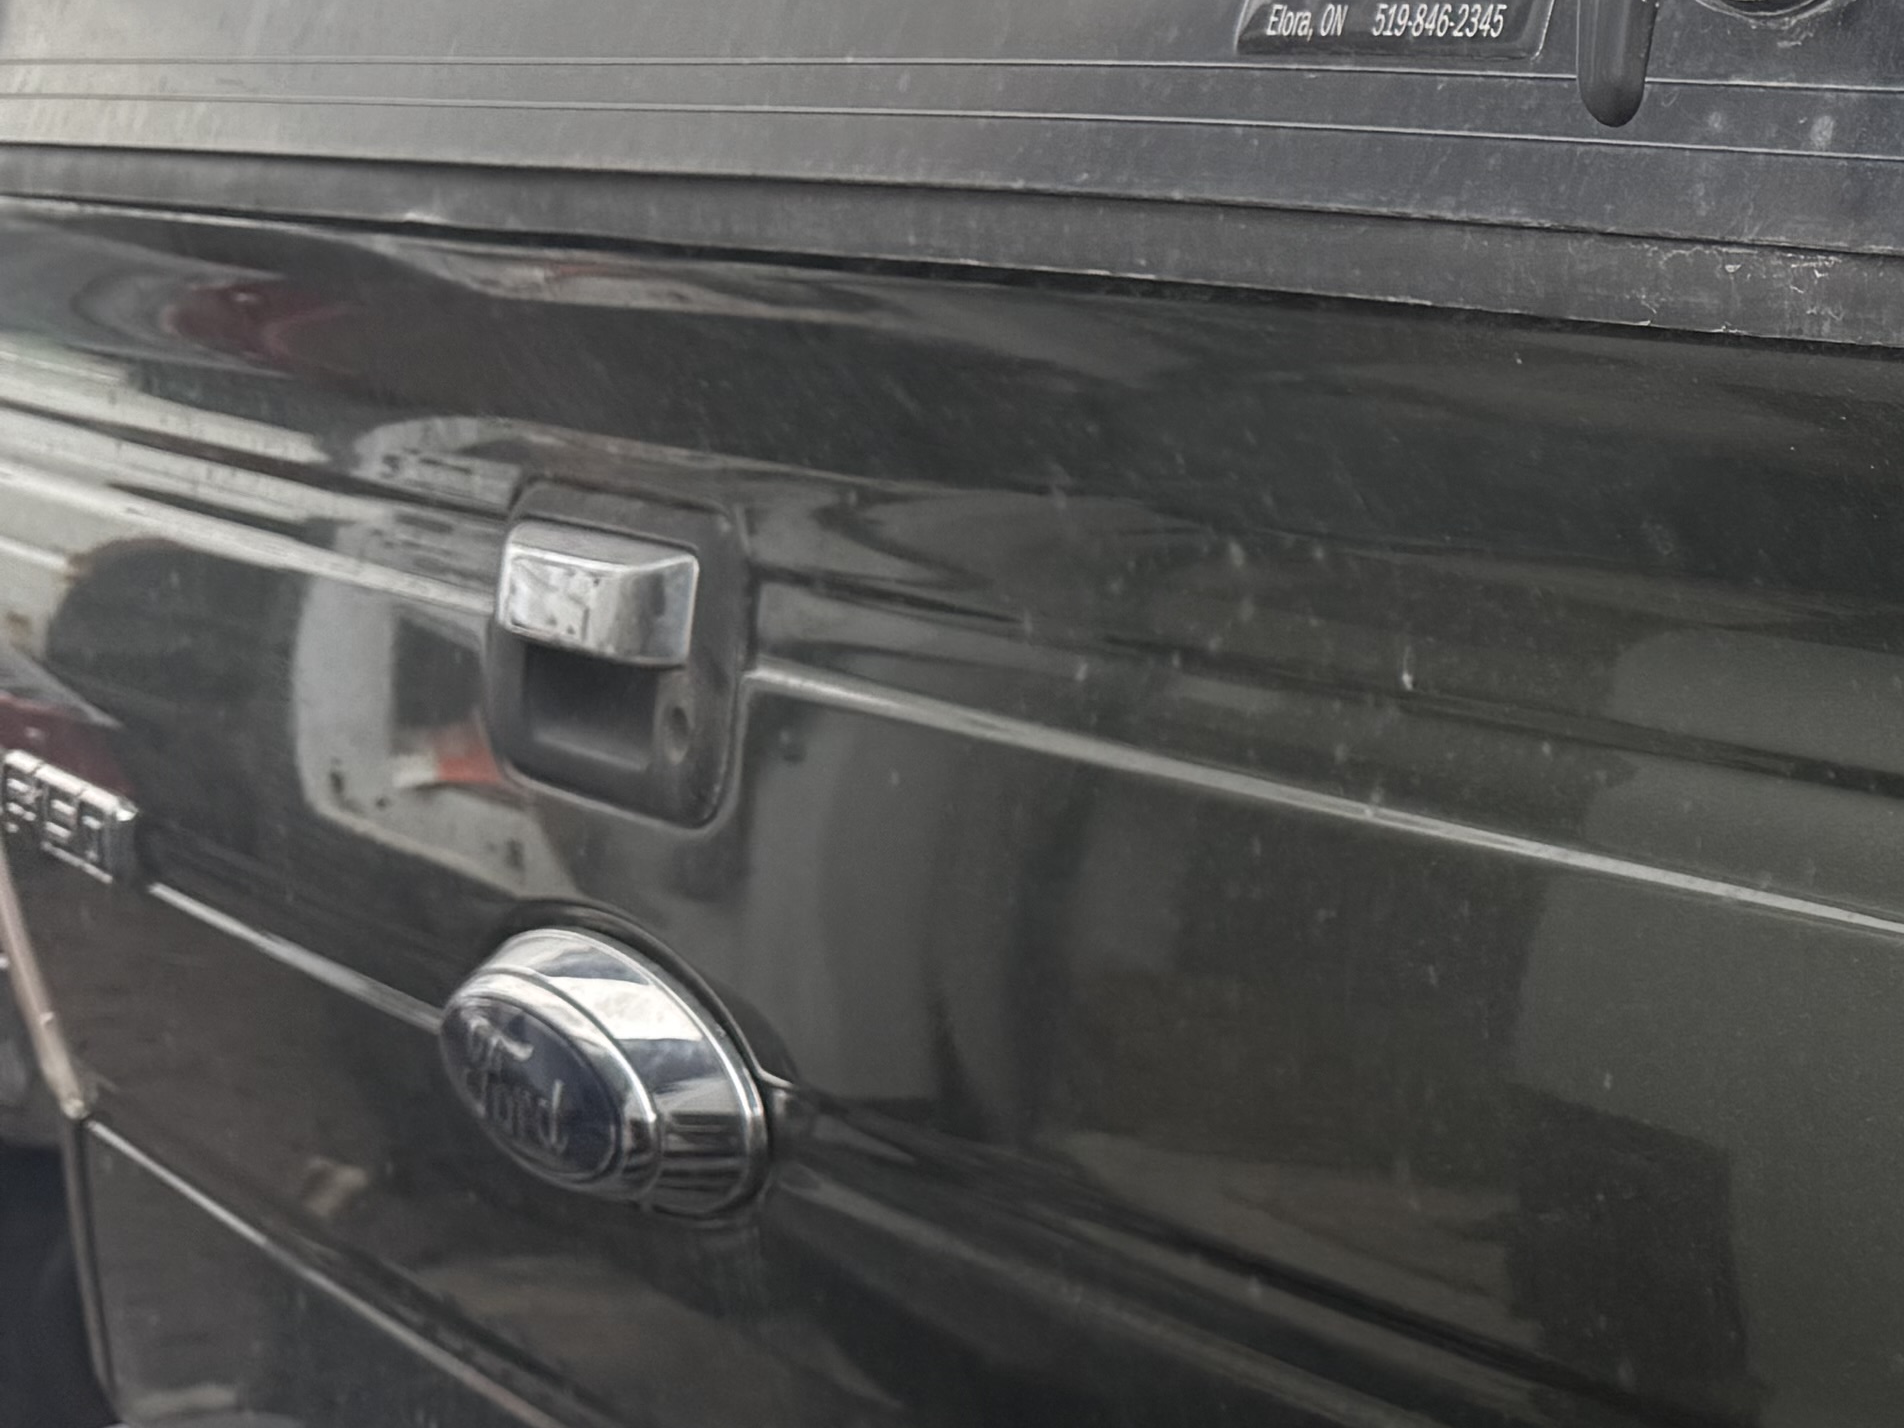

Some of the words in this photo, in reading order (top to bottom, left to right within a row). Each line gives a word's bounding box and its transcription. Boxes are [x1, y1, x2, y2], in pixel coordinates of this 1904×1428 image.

[1265, 3, 1315, 42] Elora,
[1319, 4, 1349, 37] ON
[1371, 2, 1508, 39] 519-846-2345
